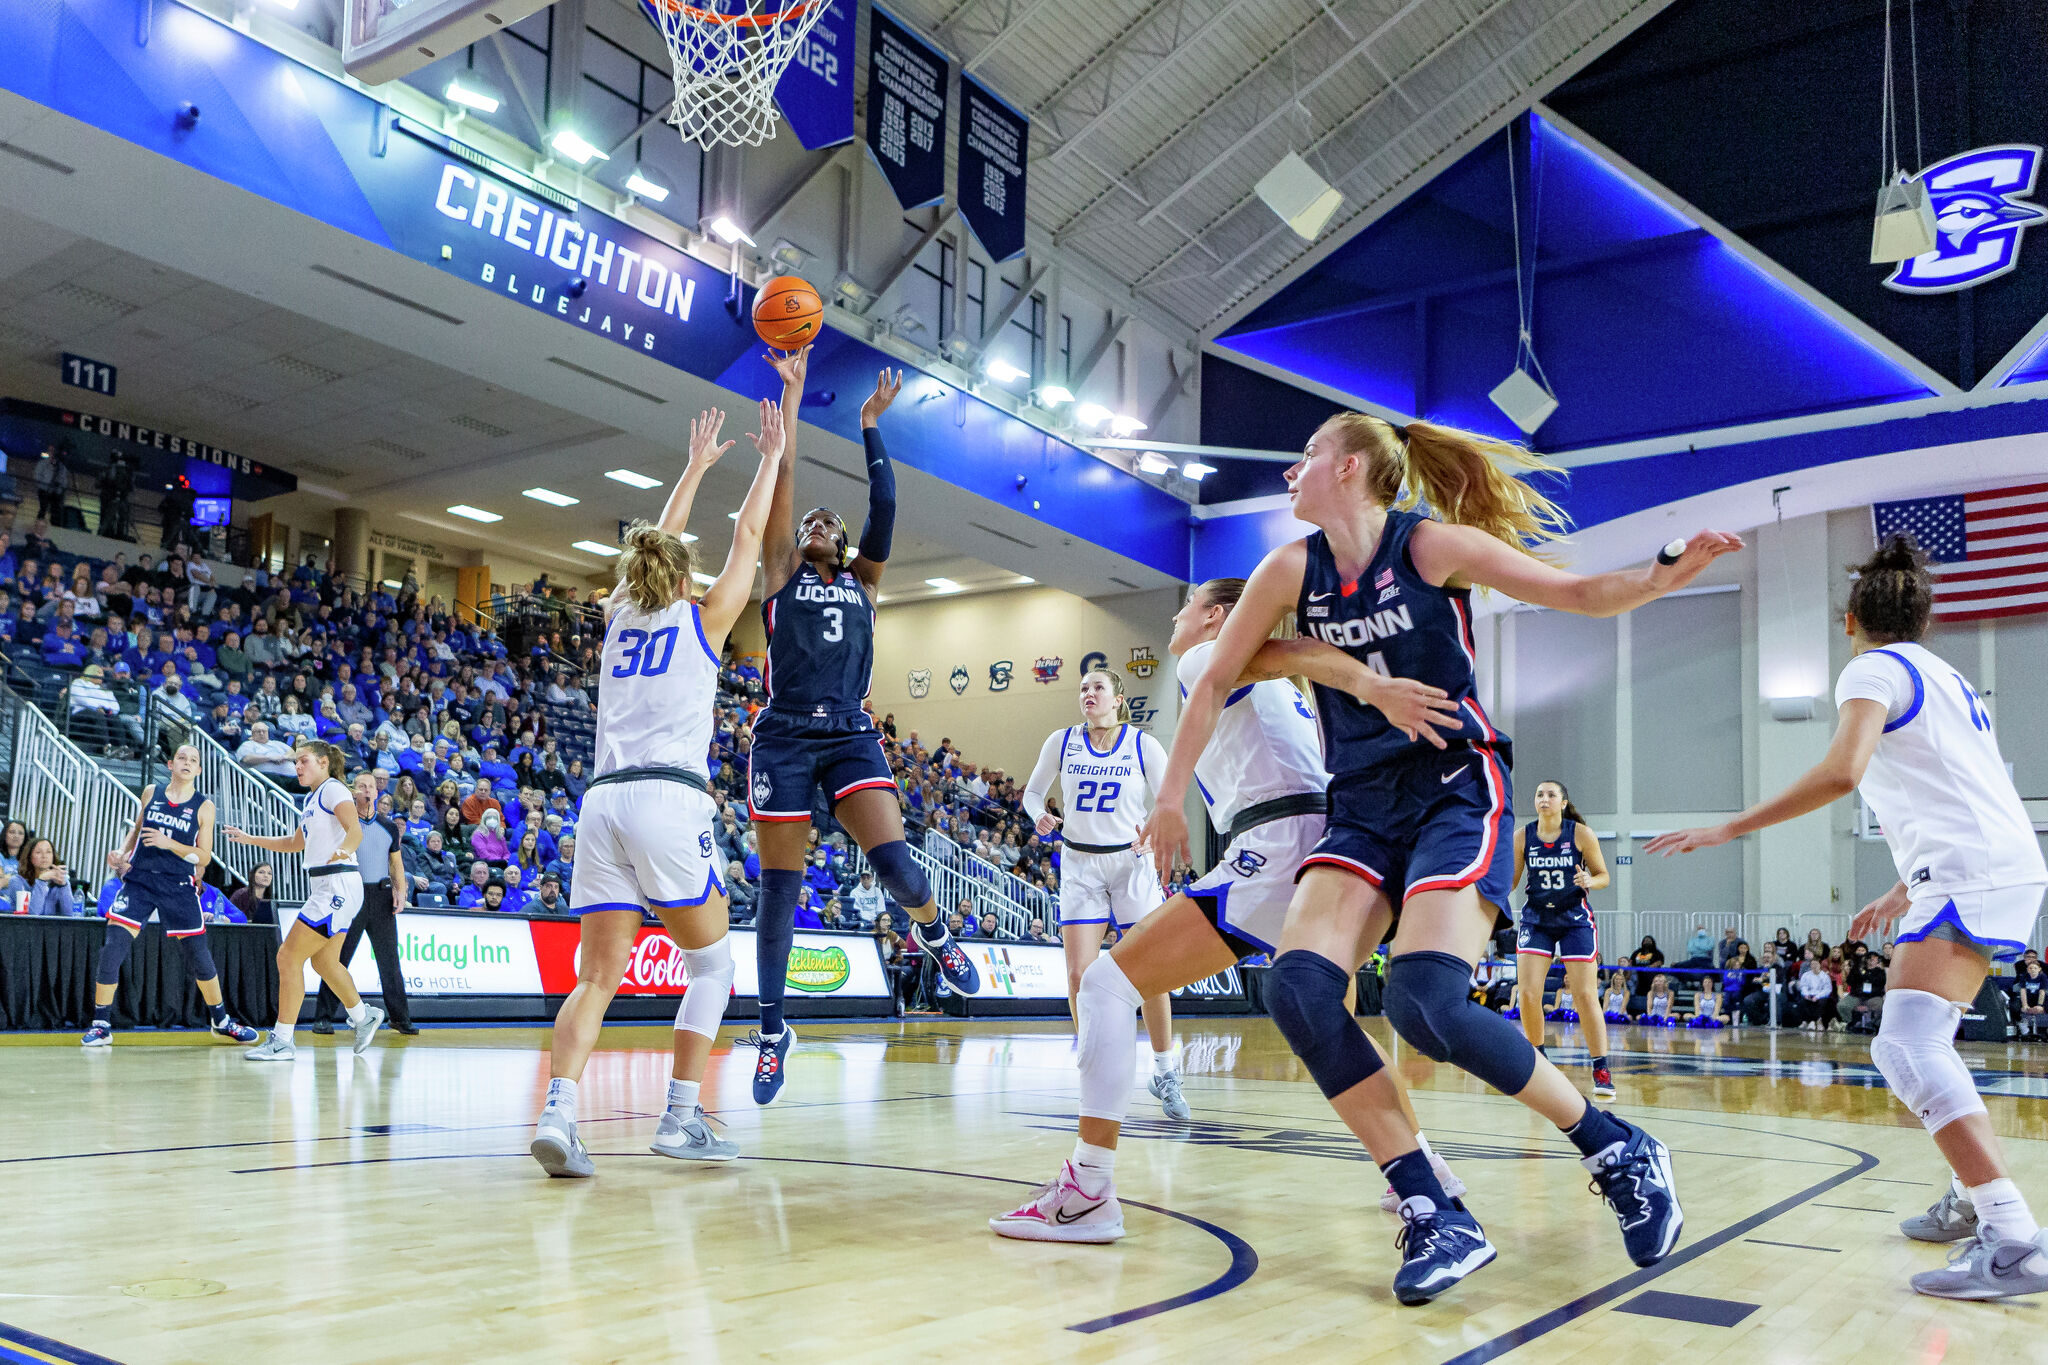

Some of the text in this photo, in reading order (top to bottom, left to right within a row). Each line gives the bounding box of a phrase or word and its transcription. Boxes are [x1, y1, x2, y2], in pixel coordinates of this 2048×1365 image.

[880, 121, 934, 152] 2002 2017
[880, 138, 905, 167] 2003
[984, 191, 1005, 217] 2012
[435, 163, 696, 322] CREIGHTON
[481, 263, 655, 350] BLUEJAYS
[69, 360, 111, 393] 111
[80, 415, 251, 474] CONCESSIONS
[795, 585, 863, 607] UCONN
[823, 607, 843, 642] 3
[1308, 604, 1414, 647] UCONN
[612, 626, 680, 678] 30
[1130, 709, 1159, 723] ST
[1067, 764, 1132, 777] CREIGHTON
[1076, 781, 1122, 812] 22
[146, 810, 191, 832] UCONN
[1529, 856, 1573, 868] UCONN
[1617, 857, 1631, 865] 114
[1538, 869, 1565, 890] 33
[371, 933, 511, 969] liday Inn
[788, 949, 846, 971] ickleman's
[404, 977, 472, 989] HG HOTEL
[1015, 965, 1043, 976] HOTELS
